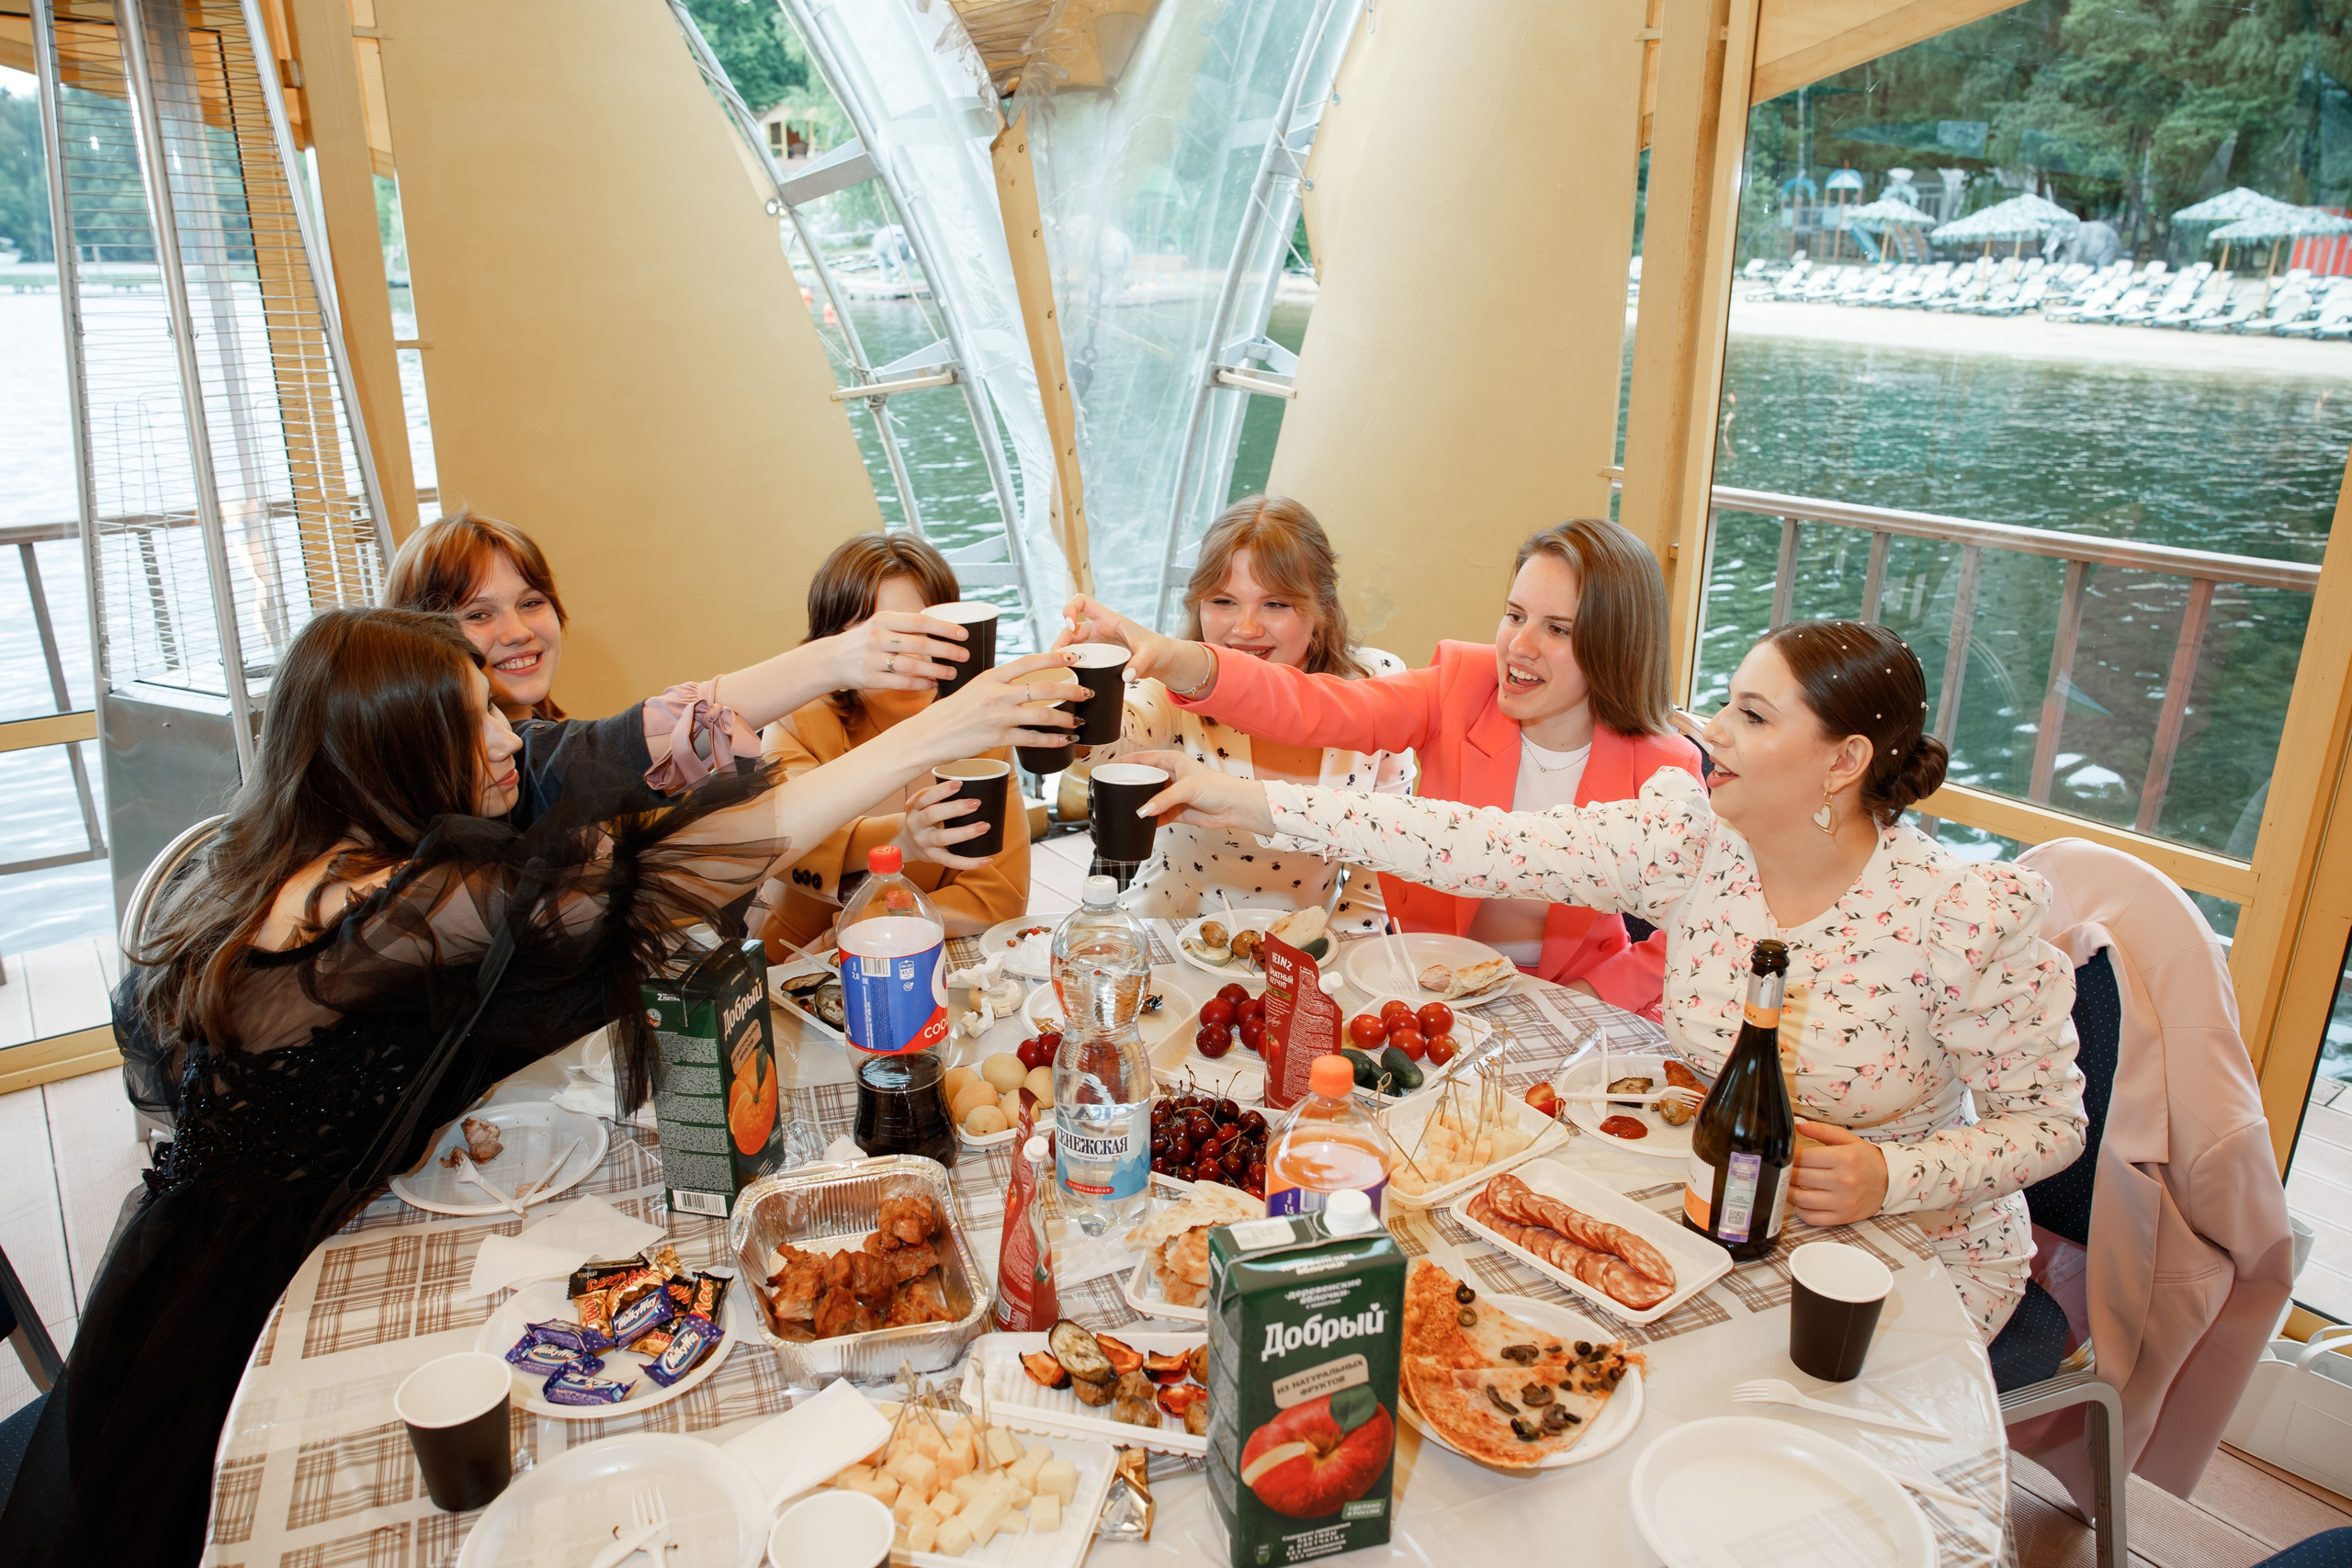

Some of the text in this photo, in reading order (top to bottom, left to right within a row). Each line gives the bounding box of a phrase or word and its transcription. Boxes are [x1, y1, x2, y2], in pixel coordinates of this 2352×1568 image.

[1272, 952, 1293, 971] EINZ
[722, 976, 763, 1042] Добрый
[1057, 1126, 1129, 1156] СЕНЕЖСКАЯ
[689, 1278, 714, 1322] Mar
[1261, 1303, 1385, 1362] Добрый
[1276, 1359, 1364, 1394] ИЗ НАТУРАЛЬНЫХ
[1300, 1375, 1346, 1395] ФРУКТОВ
